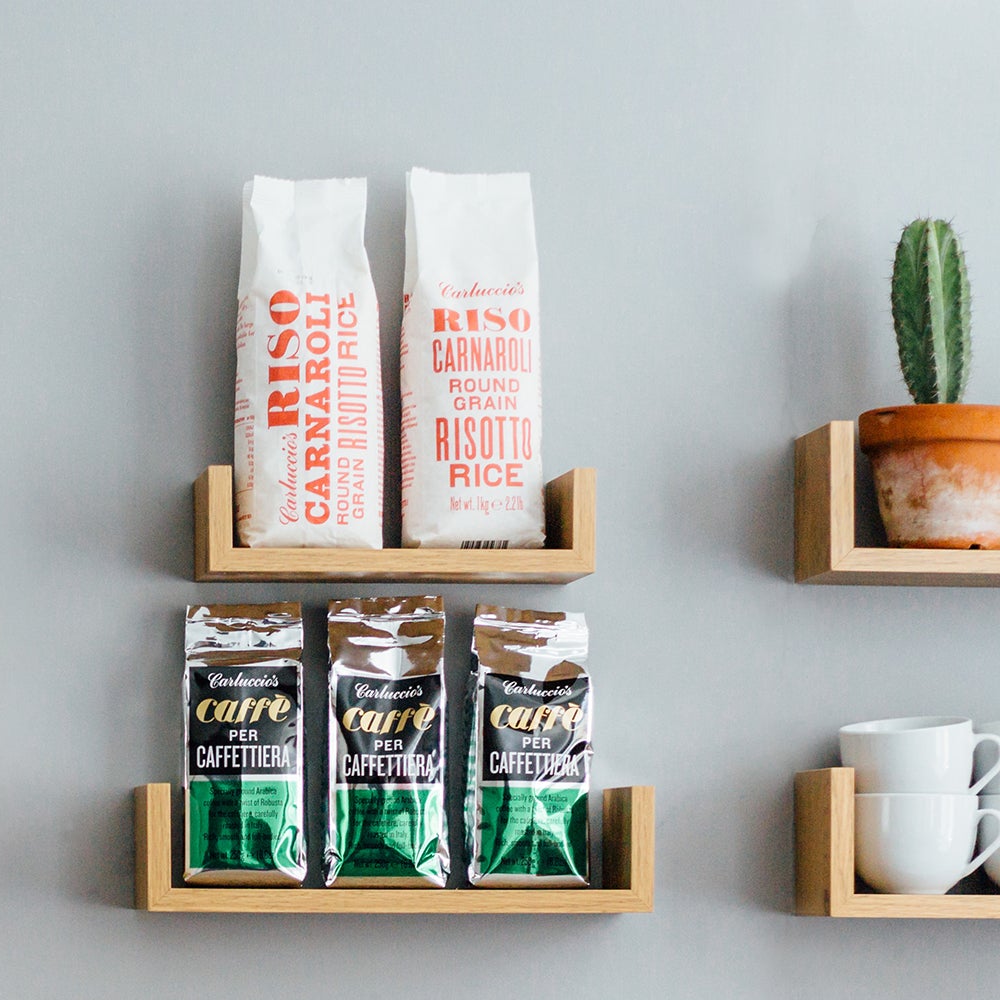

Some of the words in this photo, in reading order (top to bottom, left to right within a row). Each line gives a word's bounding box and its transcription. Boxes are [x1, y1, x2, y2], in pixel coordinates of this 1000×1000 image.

[438, 282, 524, 298] Carluccio's
[337, 292, 358, 360] RICE
[432, 308, 531, 332] RISO
[268, 290, 300, 429] RISO
[432, 336, 532, 374] CARNAROLI
[449, 378, 520, 393] ROUND
[304, 292, 330, 524] CARNAROLI
[338, 367, 367, 450] RISOTTO
[454, 396, 517, 411] GRAIN
[435, 416, 532, 462] RISOTTO
[278, 433, 298, 526] Carluccio's
[448, 463, 524, 488] RICE
[336, 456, 350, 525] ROUND
[352, 459, 364, 520] GRAIN
[208, 672, 278, 688] Carluccio's
[354, 682, 423, 700] Carluccio's
[502, 680, 572, 696] Carluccio's
[196, 694, 291, 724] caffè
[342, 702, 436, 734] caffè
[490, 702, 584, 732] caffè
[229, 730, 258, 742] PER
[374, 740, 403, 752] PER
[522, 737, 551, 749] PER
[196, 745, 290, 768] CAFFETTIERA
[343, 754, 434, 776] CAFFETTIERA
[490, 751, 580, 776] CAFFETTIERA
